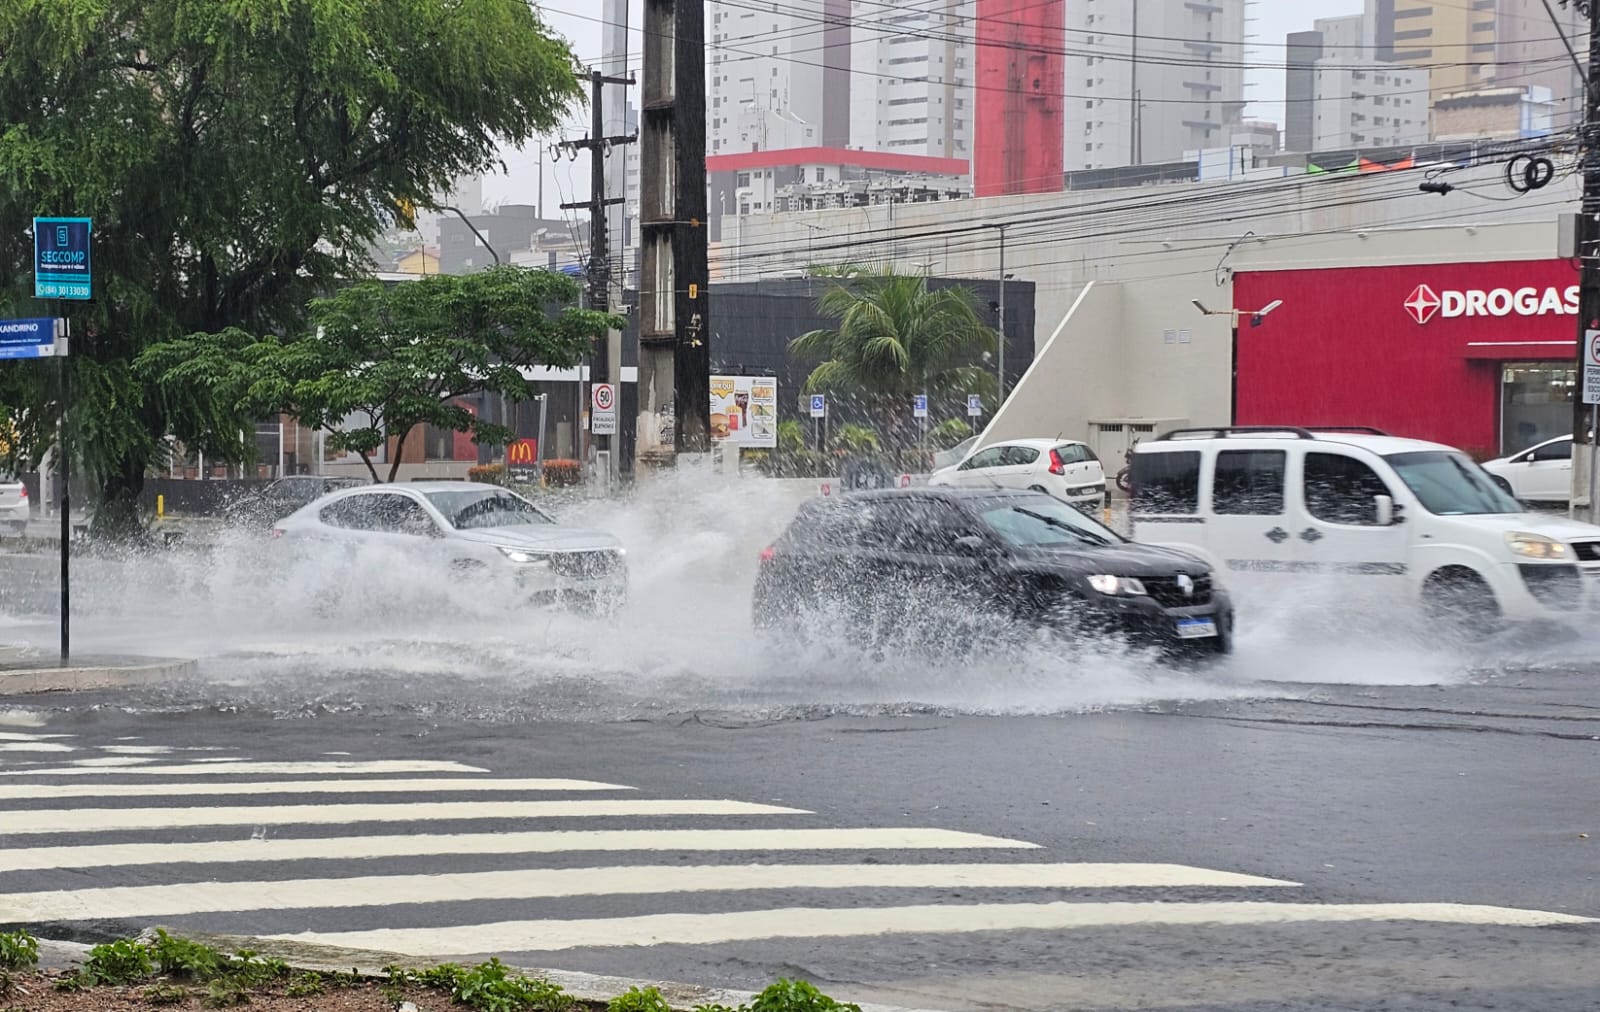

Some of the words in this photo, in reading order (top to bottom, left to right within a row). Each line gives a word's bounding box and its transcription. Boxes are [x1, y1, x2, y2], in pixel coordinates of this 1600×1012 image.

[41, 250, 85, 263] SEGCOMP
[58, 286, 89, 296] 30133030
[599, 390, 610, 402] 50
